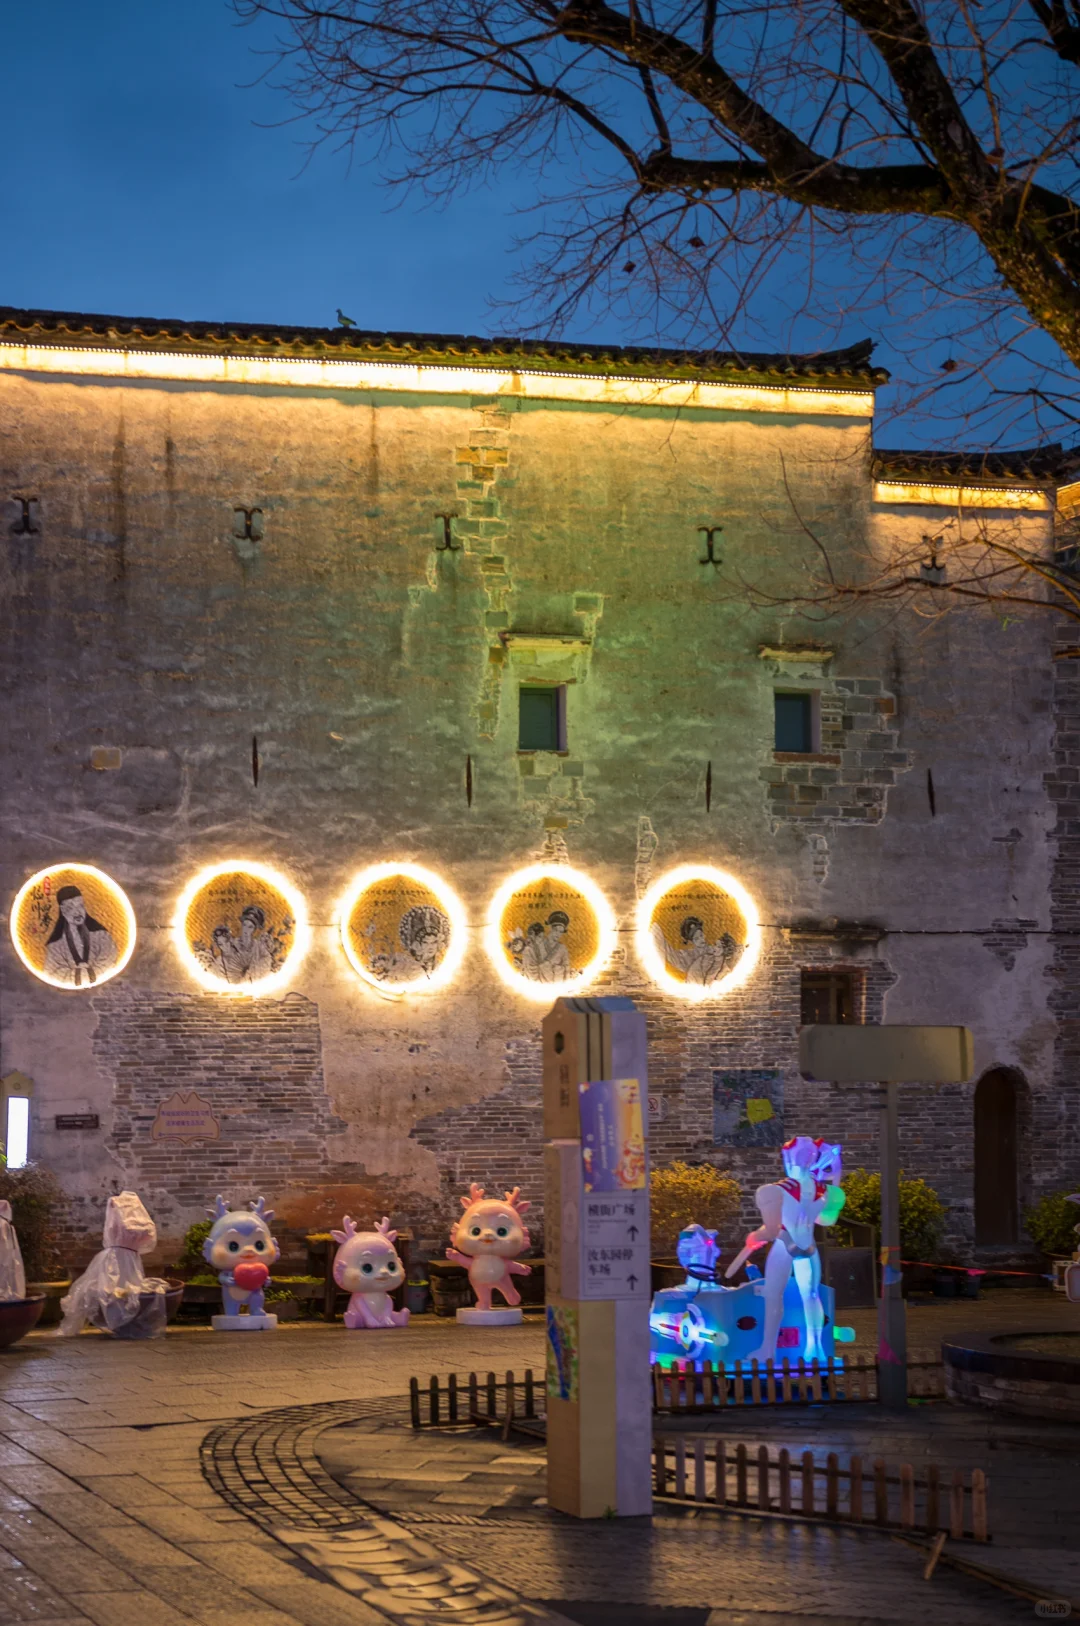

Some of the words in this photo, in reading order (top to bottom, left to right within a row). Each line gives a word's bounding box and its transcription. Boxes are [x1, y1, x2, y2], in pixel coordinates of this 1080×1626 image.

[588, 1203, 636, 1217] 横街广场
[588, 1263, 611, 1276] 车场
